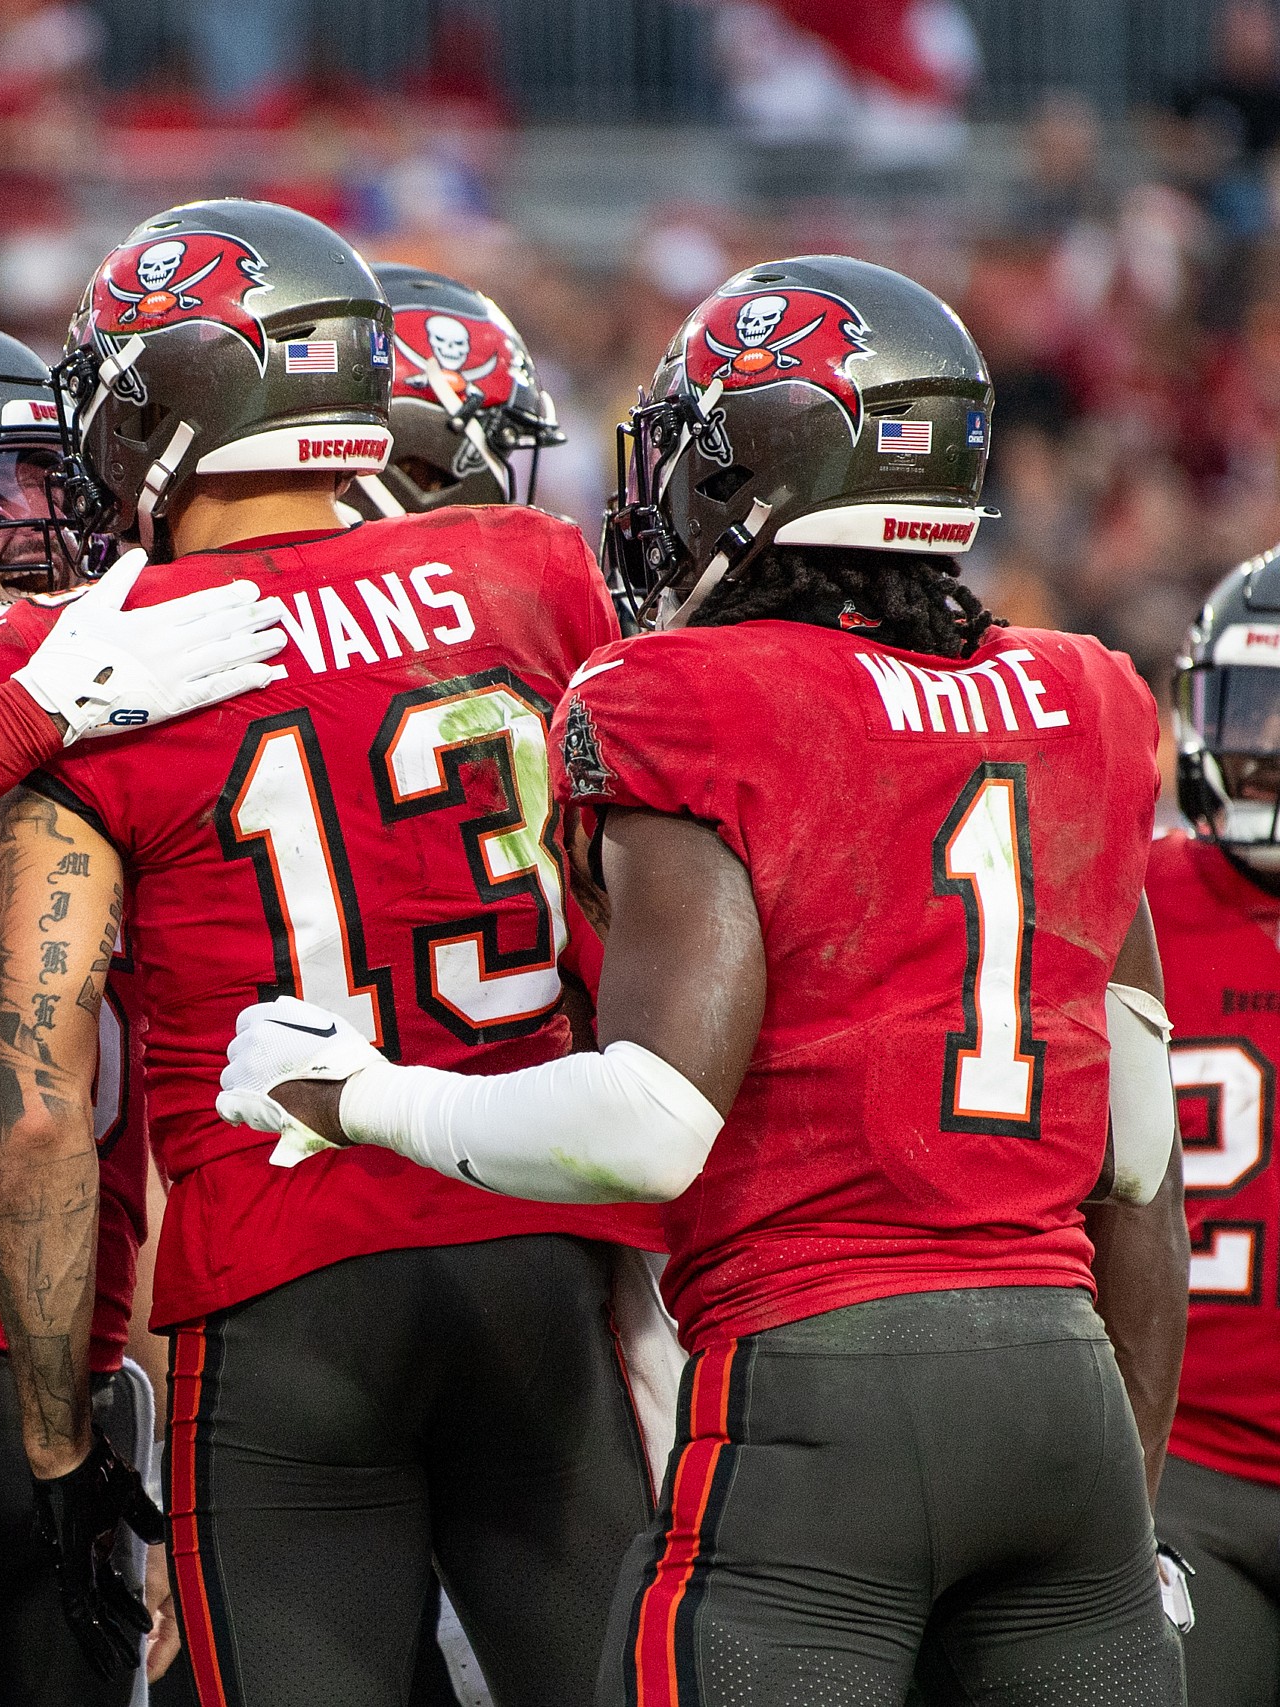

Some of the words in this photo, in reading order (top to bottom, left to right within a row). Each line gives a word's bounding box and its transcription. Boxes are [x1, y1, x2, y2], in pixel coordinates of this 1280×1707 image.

[270, 562, 476, 681] VANS
[854, 649, 1070, 733] WHITE
[214, 666, 570, 1062] 13
[932, 761, 1048, 1139] 1
[1169, 1036, 1280, 1305] 2
